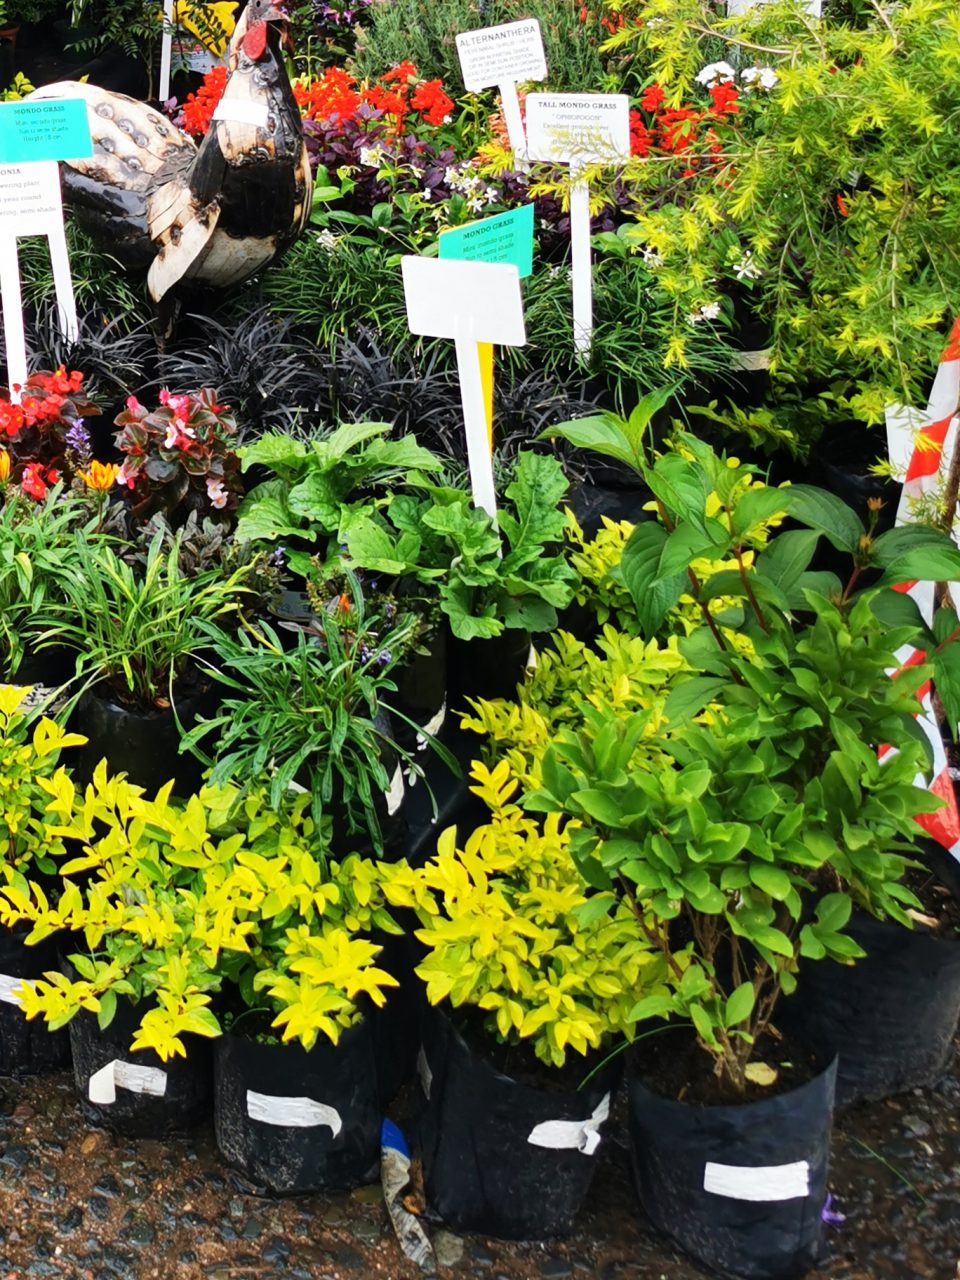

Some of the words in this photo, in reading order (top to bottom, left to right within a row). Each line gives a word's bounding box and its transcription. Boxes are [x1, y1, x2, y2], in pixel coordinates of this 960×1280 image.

[460, 26, 535, 47] ALTERNANTHERA
[14, 107, 42, 115] MONDO
[43, 105, 65, 113] GRASS
[23, 180, 41, 188] plant
[4, 196, 19, 204] year
[20, 193, 42, 201] round
[37, 205, 57, 213] shade
[463, 225, 492, 240] MONDO
[492, 217, 514, 231] GRASS
